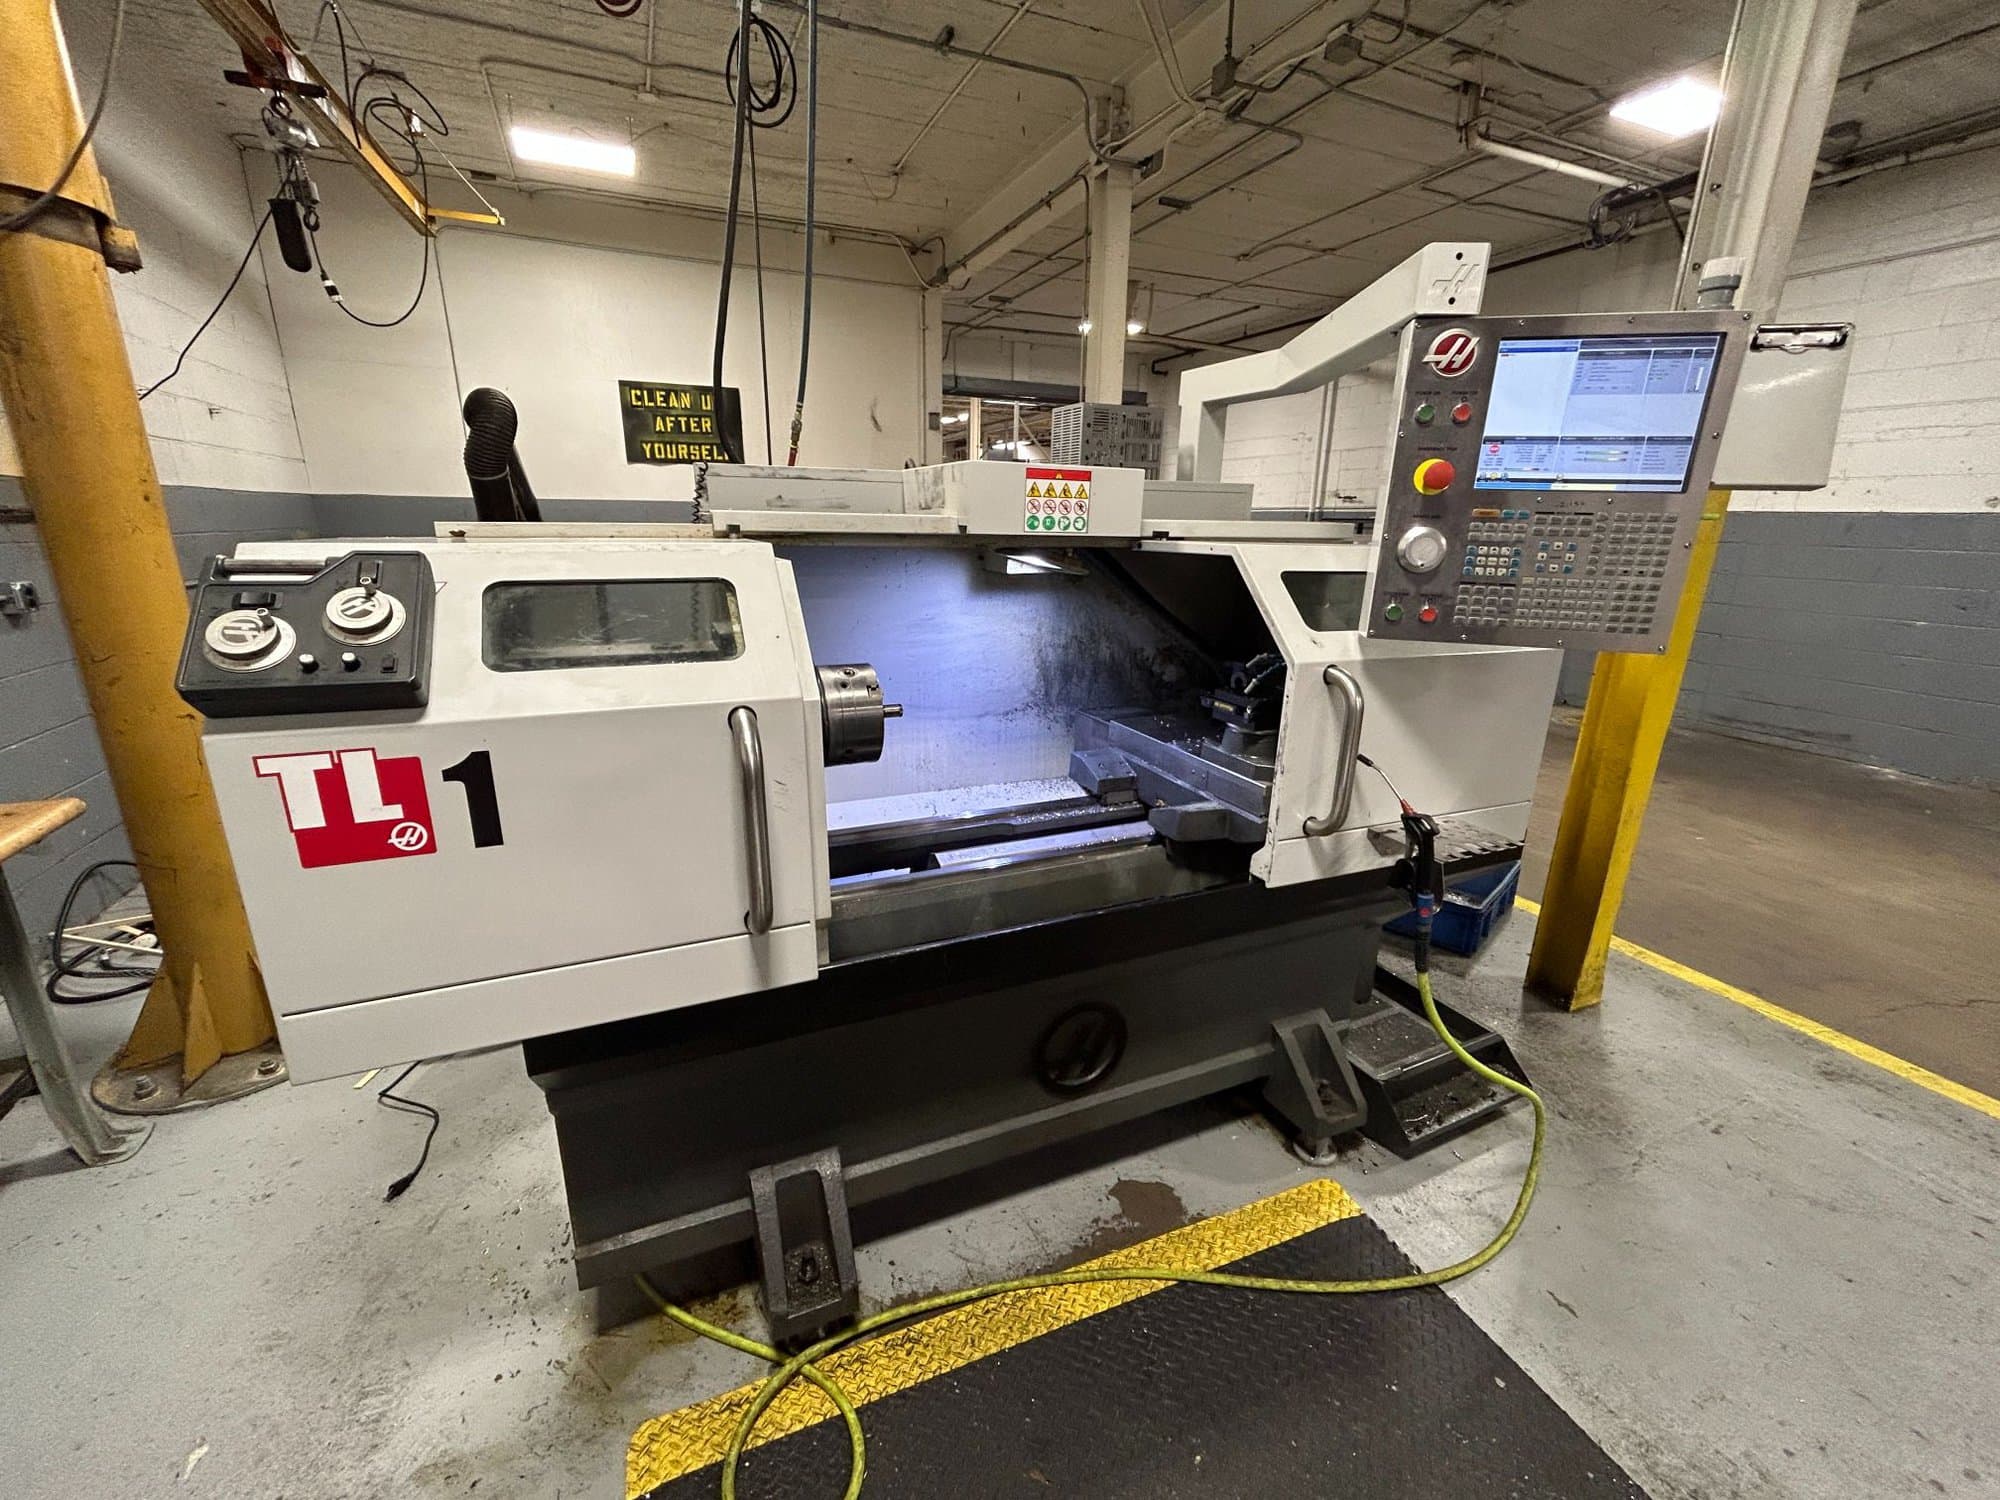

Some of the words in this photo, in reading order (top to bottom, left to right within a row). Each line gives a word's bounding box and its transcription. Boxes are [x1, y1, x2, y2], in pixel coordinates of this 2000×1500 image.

[630, 389, 691, 409] CLEAN
[701, 394, 714, 411] U
[655, 416, 712, 433] AFTER
[252, 748, 404, 832] TL
